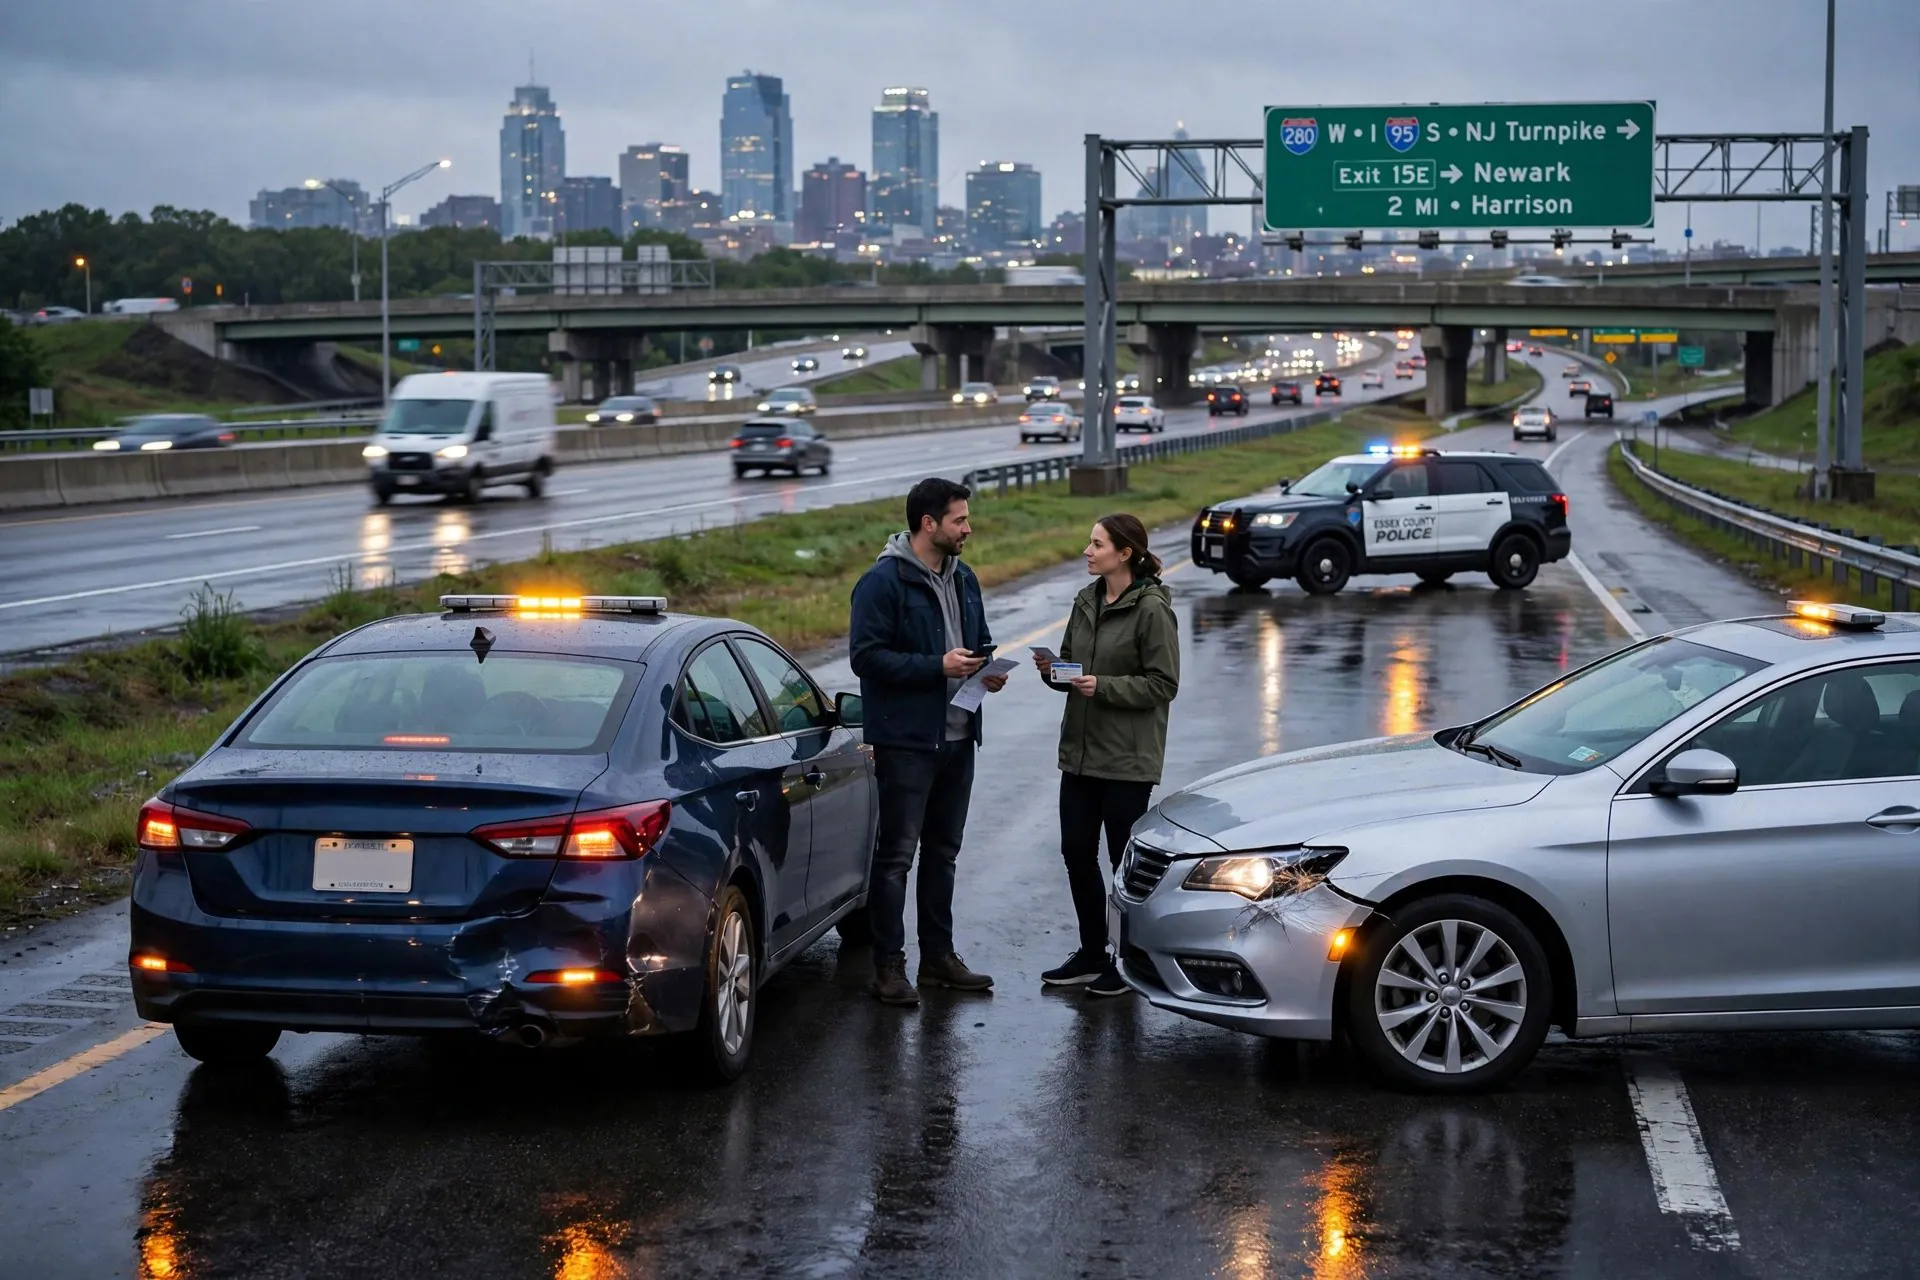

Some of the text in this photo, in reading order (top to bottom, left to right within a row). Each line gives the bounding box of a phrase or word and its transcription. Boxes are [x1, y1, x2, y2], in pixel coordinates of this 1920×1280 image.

[1285, 128, 1315, 145] 280
[1328, 123, 1346, 143] W
[1391, 126, 1414, 143] 95
[1426, 122, 1441, 142] S
[1466, 121, 1496, 142] NJ
[1505, 120, 1607, 145] Turnpike
[1339, 161, 1571, 184] Exit 15E Newark
[1388, 194, 1573, 216] 2 MI Harrison
[1374, 516, 1436, 529] ESSEX COUNTY
[1375, 527, 1432, 543] POLICE
